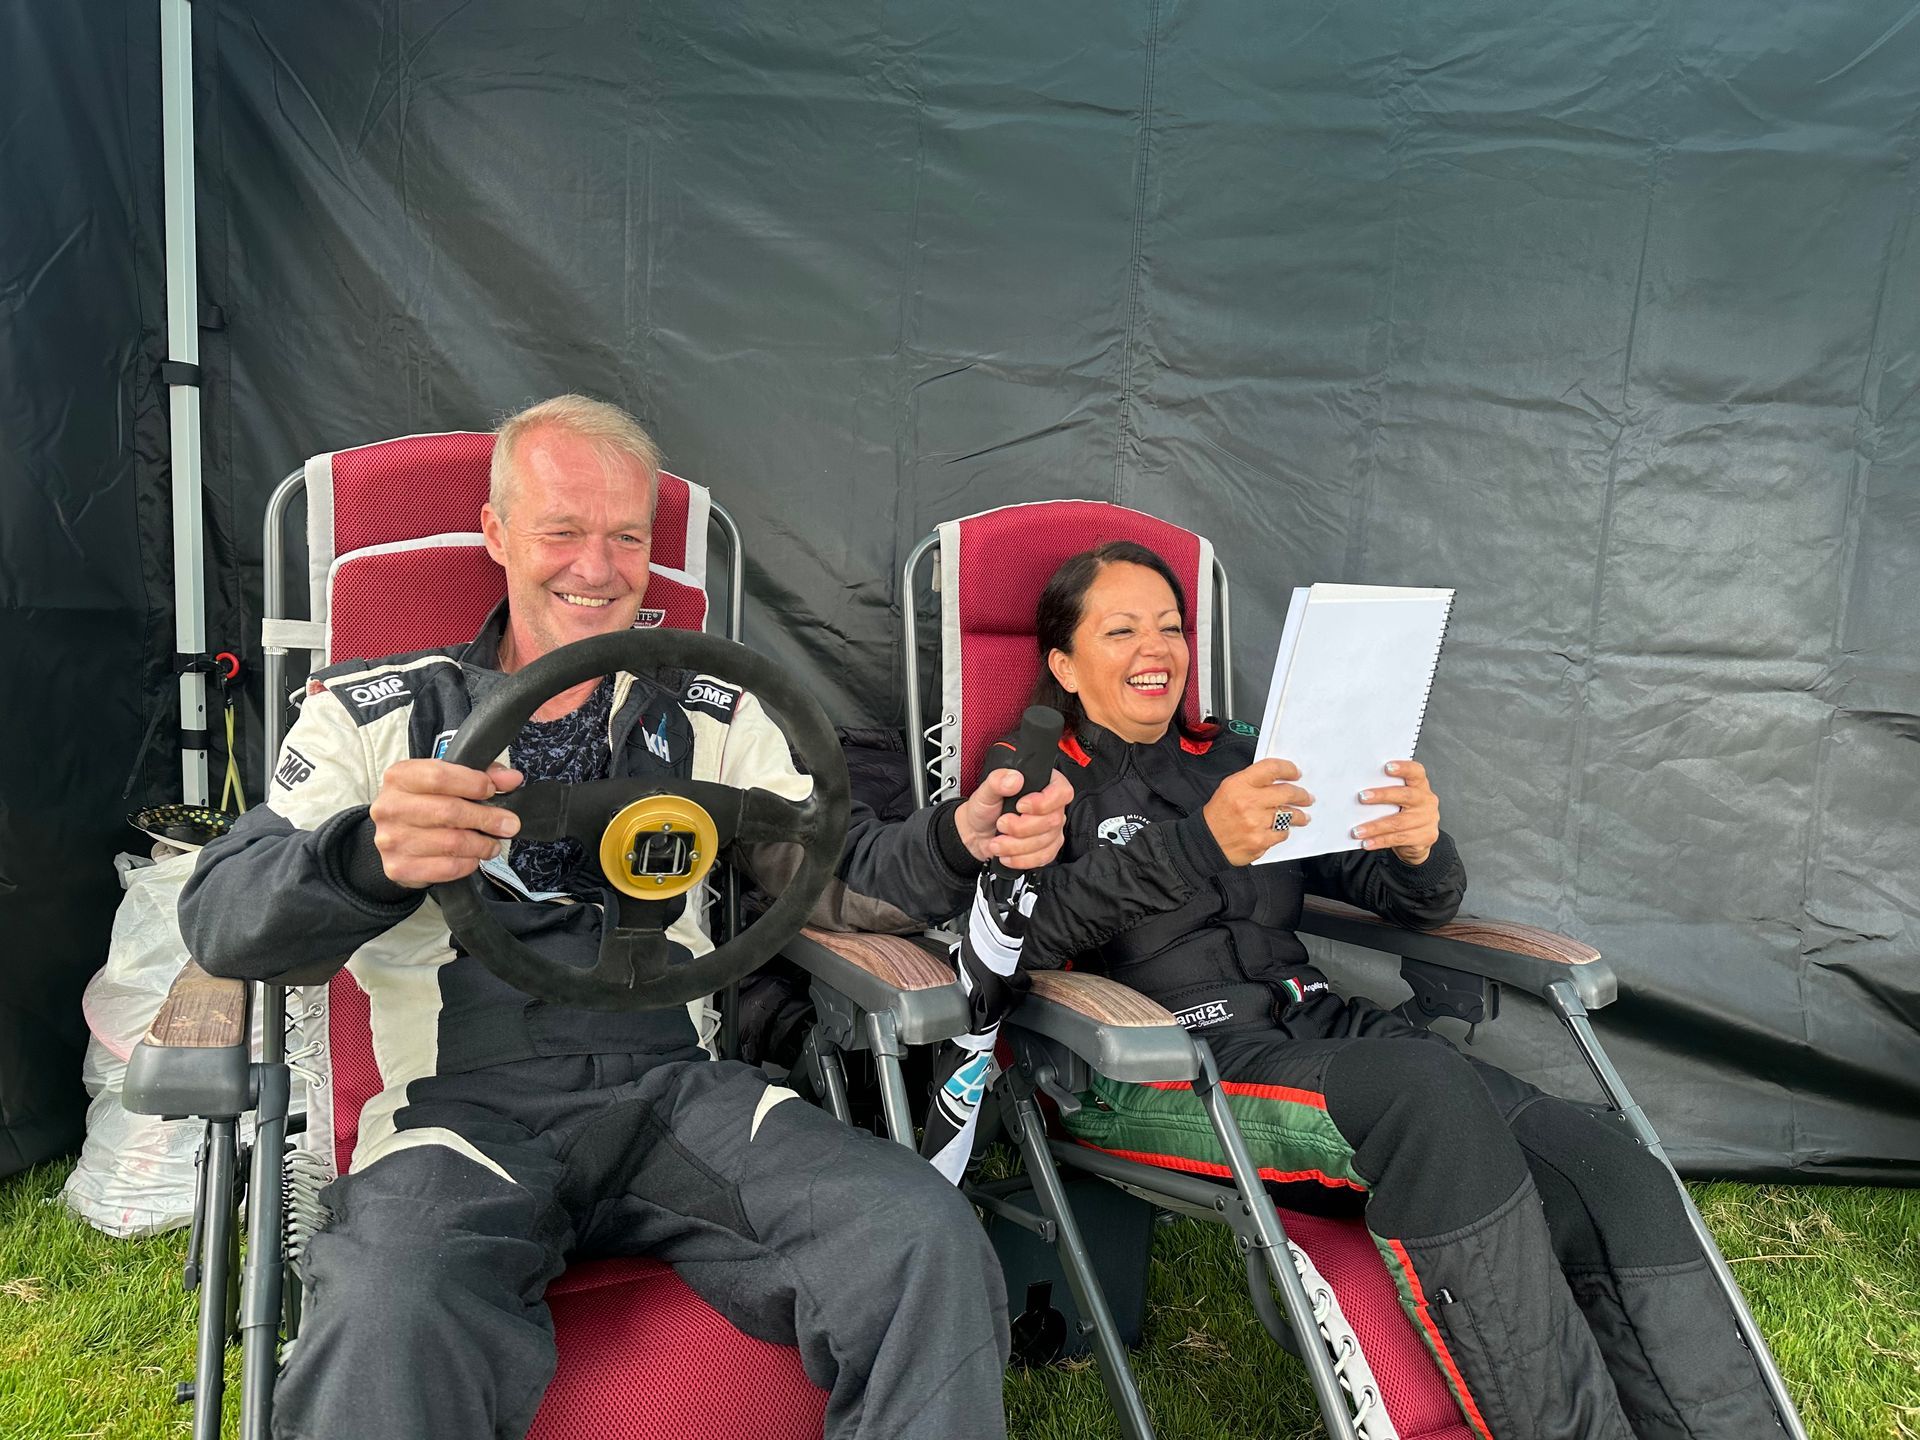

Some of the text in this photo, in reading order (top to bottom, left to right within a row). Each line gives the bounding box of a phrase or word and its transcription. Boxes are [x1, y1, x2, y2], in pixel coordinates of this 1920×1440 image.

[351, 678, 404, 703] OMP
[686, 685, 732, 706] OMP
[1176, 1003, 1227, 1026] and21
